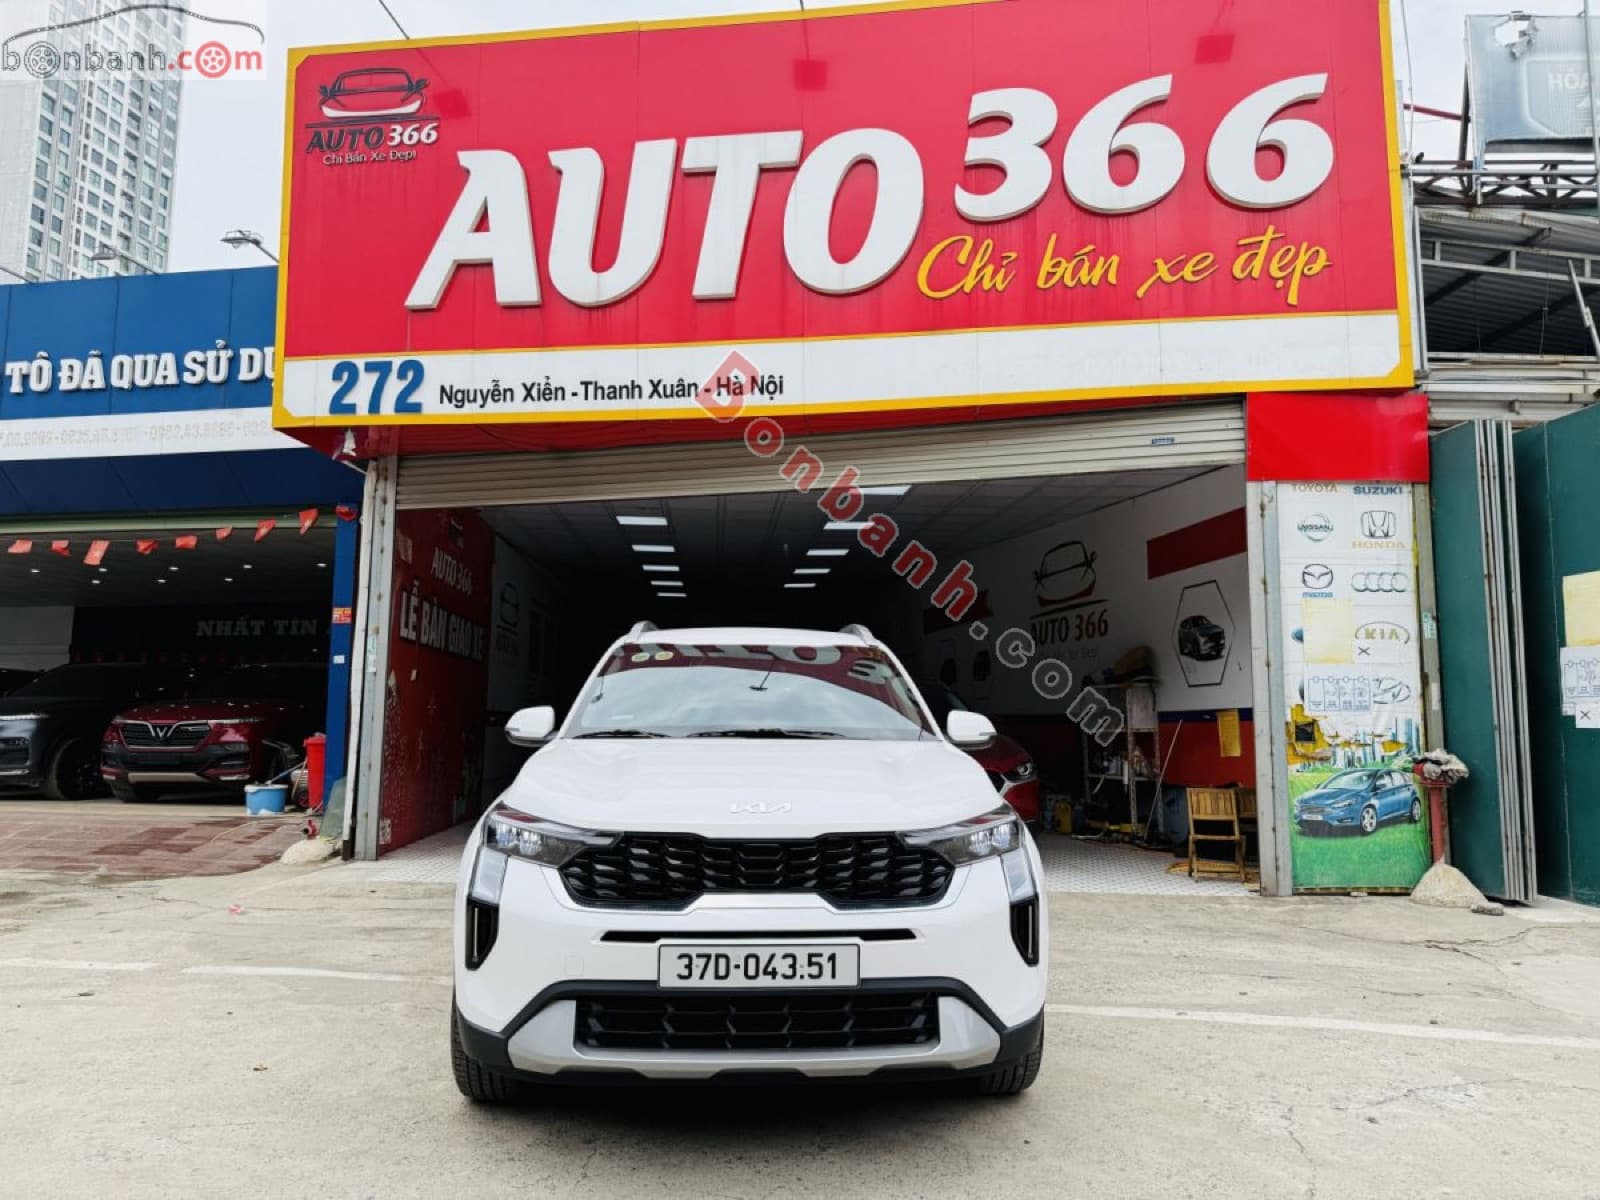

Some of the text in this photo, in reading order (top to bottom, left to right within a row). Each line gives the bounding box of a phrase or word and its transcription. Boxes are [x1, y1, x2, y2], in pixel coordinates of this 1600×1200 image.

[305, 122, 438, 153] AUTO 366
[404, 72, 1335, 310] AUTO 366
[917, 225, 1332, 306] Chỉ bán xe đẹp
[5, 351, 53, 394] TÔ
[58, 350, 107, 392] ĐÃ
[110, 352, 180, 390] QUA
[183, 339, 234, 384] SỬ
[328, 359, 425, 415] 272
[439, 379, 514, 408] Nguyễn
[521, 375, 566, 401] Xiển
[648, 377, 699, 399] Xuân
[716, 375, 744, 396] Hà
[750, 374, 784, 401] Nội
[1353, 485, 1403, 496] SUZUKI
[1352, 540, 1405, 549] HONDA
[430, 546, 457, 587] AUTO
[1074, 608, 1109, 641] 366
[1365, 628, 1400, 640] KIA
[676, 952, 838, 980] 37D-043.51
